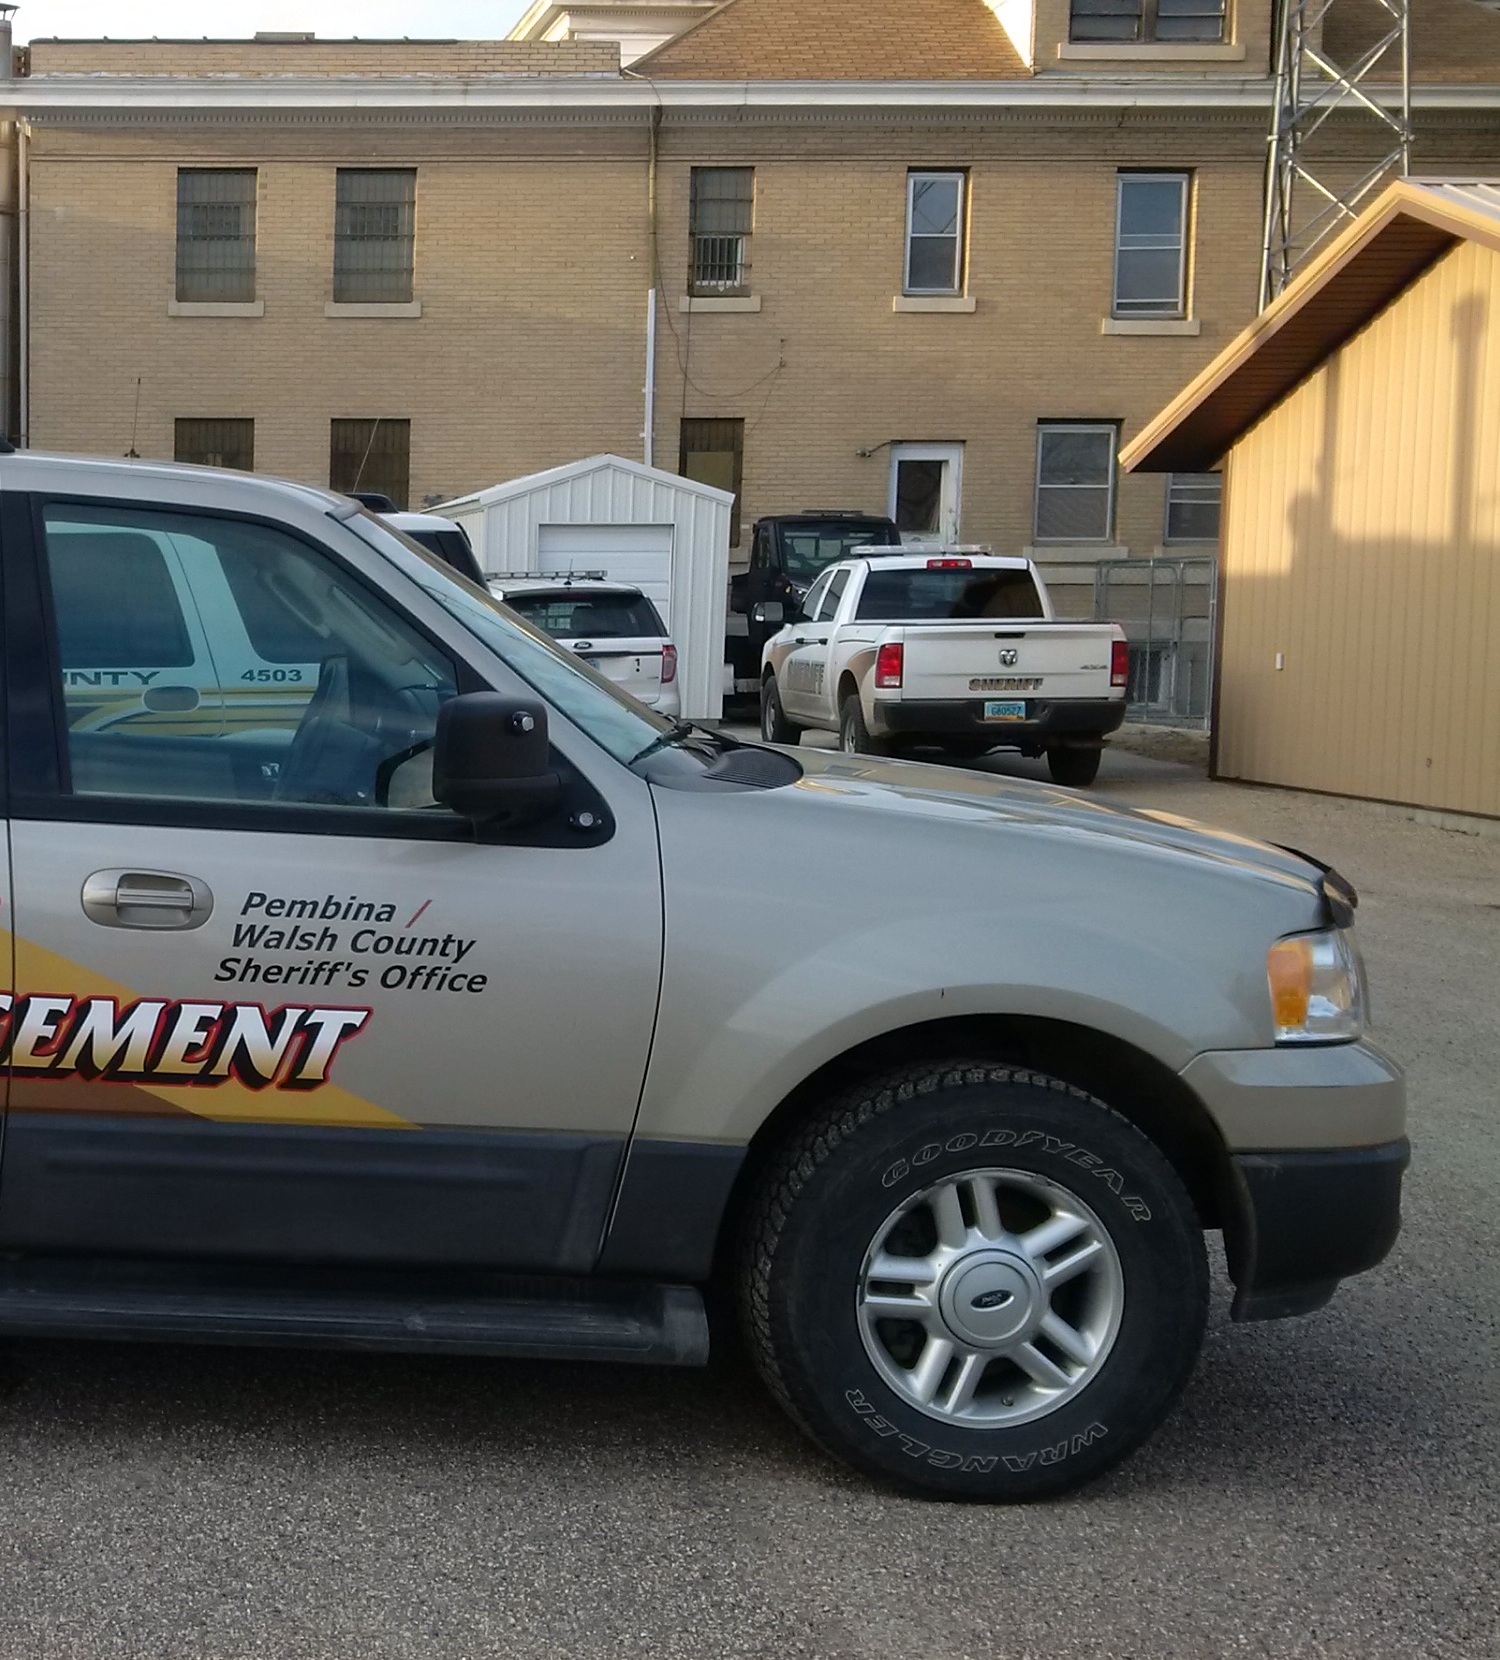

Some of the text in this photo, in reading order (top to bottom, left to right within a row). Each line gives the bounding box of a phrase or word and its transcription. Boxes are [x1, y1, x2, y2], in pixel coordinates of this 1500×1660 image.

[63, 671, 160, 685] NTY
[241, 669, 302, 682] 4503
[968, 678, 1044, 691] SHERIFF
[240, 892, 397, 923] Pembina
[231, 923, 477, 964] Walsh County
[214, 957, 488, 993] Sheriff's Office
[881, 1129, 1152, 1222] GOODYEAR
[845, 1388, 1109, 1474] WRANGLER
